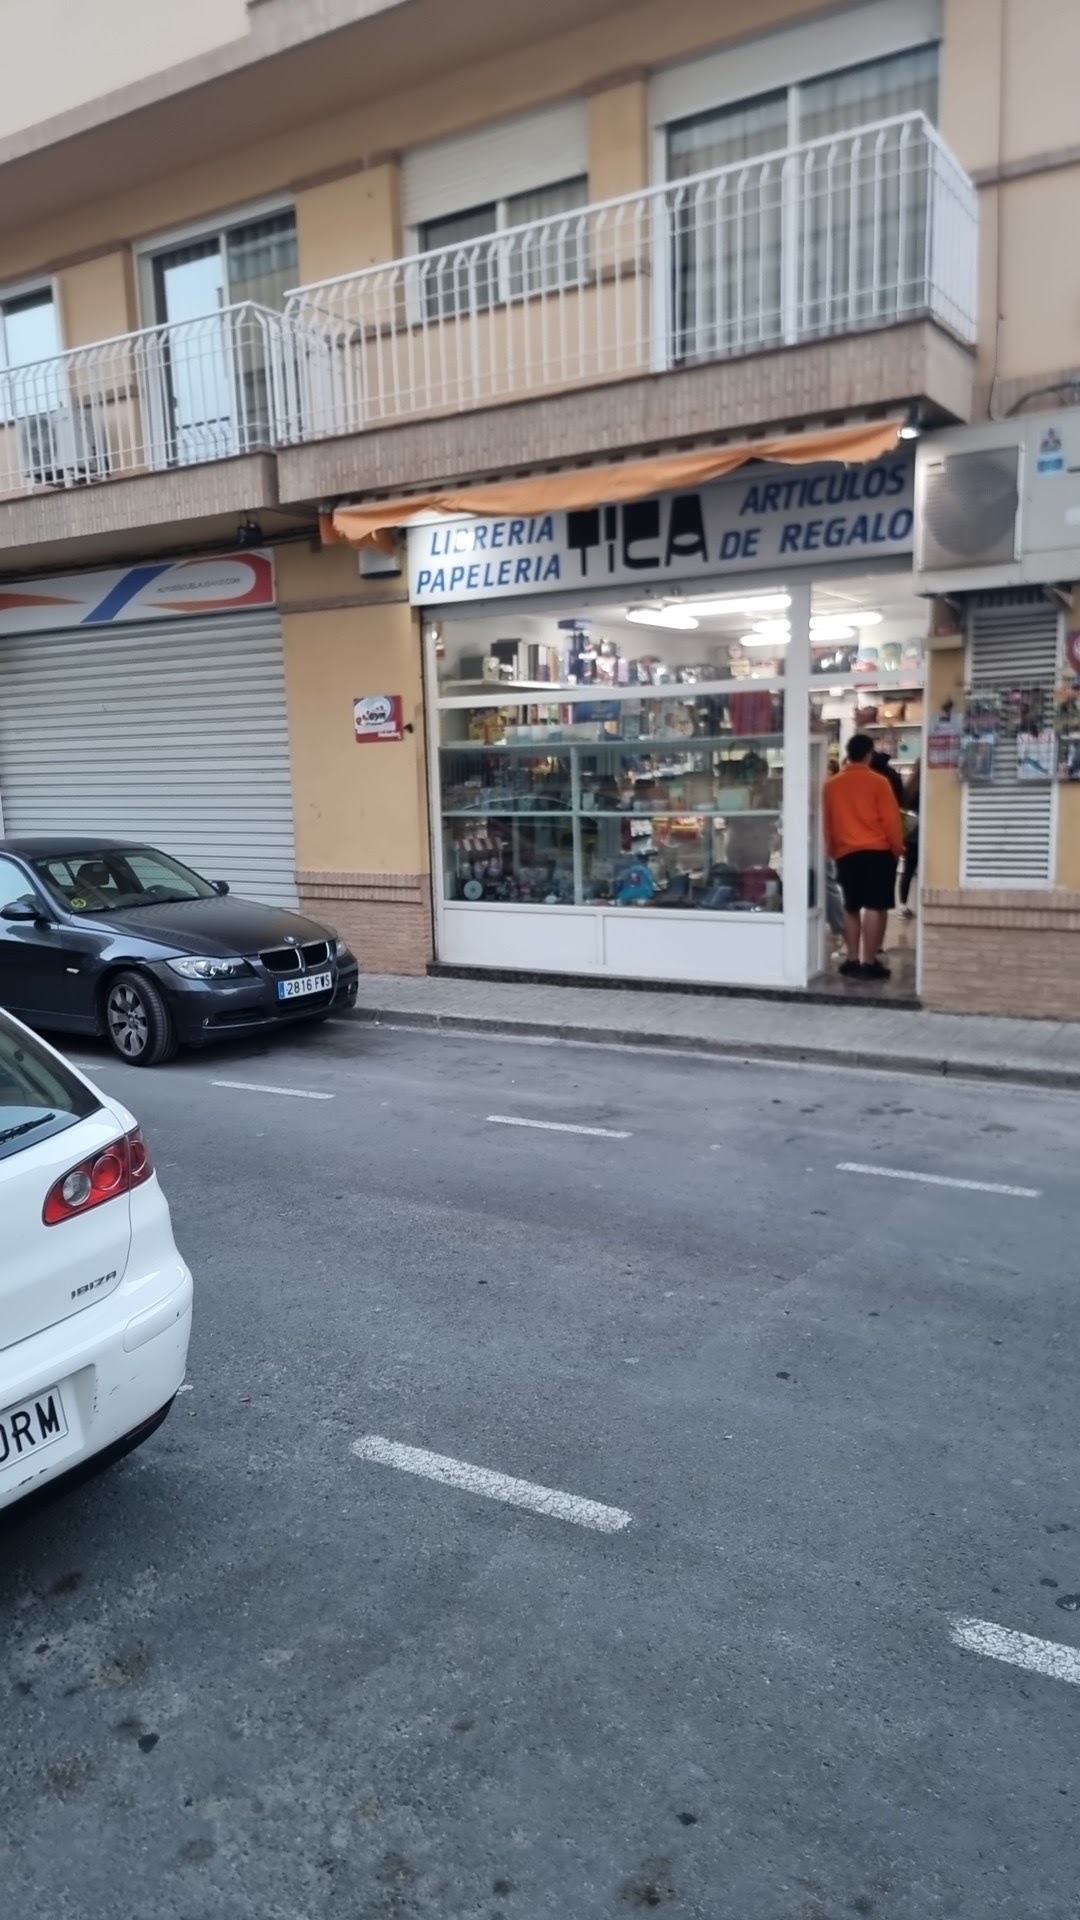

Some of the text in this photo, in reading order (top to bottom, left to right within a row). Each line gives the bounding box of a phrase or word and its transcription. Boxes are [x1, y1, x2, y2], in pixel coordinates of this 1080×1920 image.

[739, 464, 906, 516] ARTICULOS
[719, 508, 914, 560] DE REGALO
[416, 553, 562, 595] PAPELERIA
[287, 978, 312, 995] 2816
[71, 1269, 117, 1300] IBIZA
